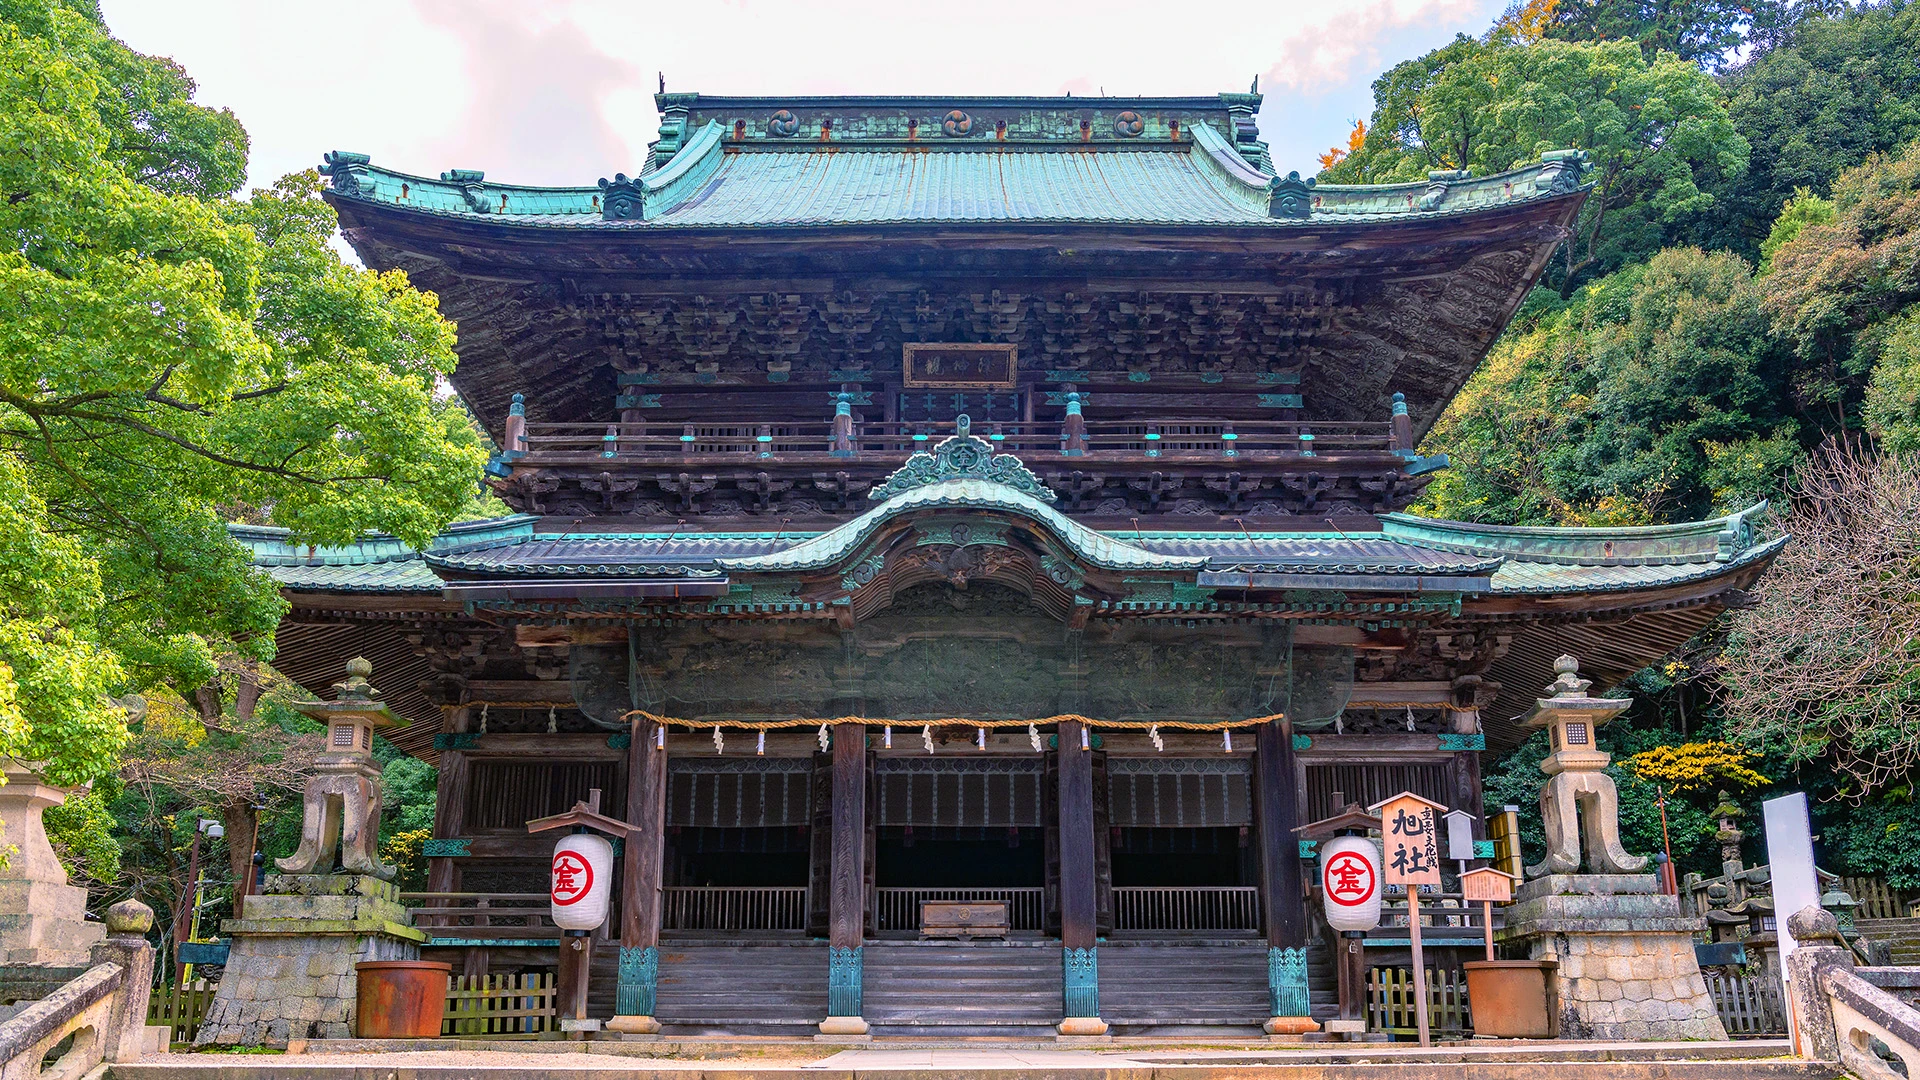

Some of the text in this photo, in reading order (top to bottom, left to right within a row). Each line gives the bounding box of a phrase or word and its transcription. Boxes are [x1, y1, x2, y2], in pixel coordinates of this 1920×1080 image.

[1391, 808, 1430, 876] 旭社
[554, 858, 583, 894] 金
[1330, 858, 1366, 895] 金
